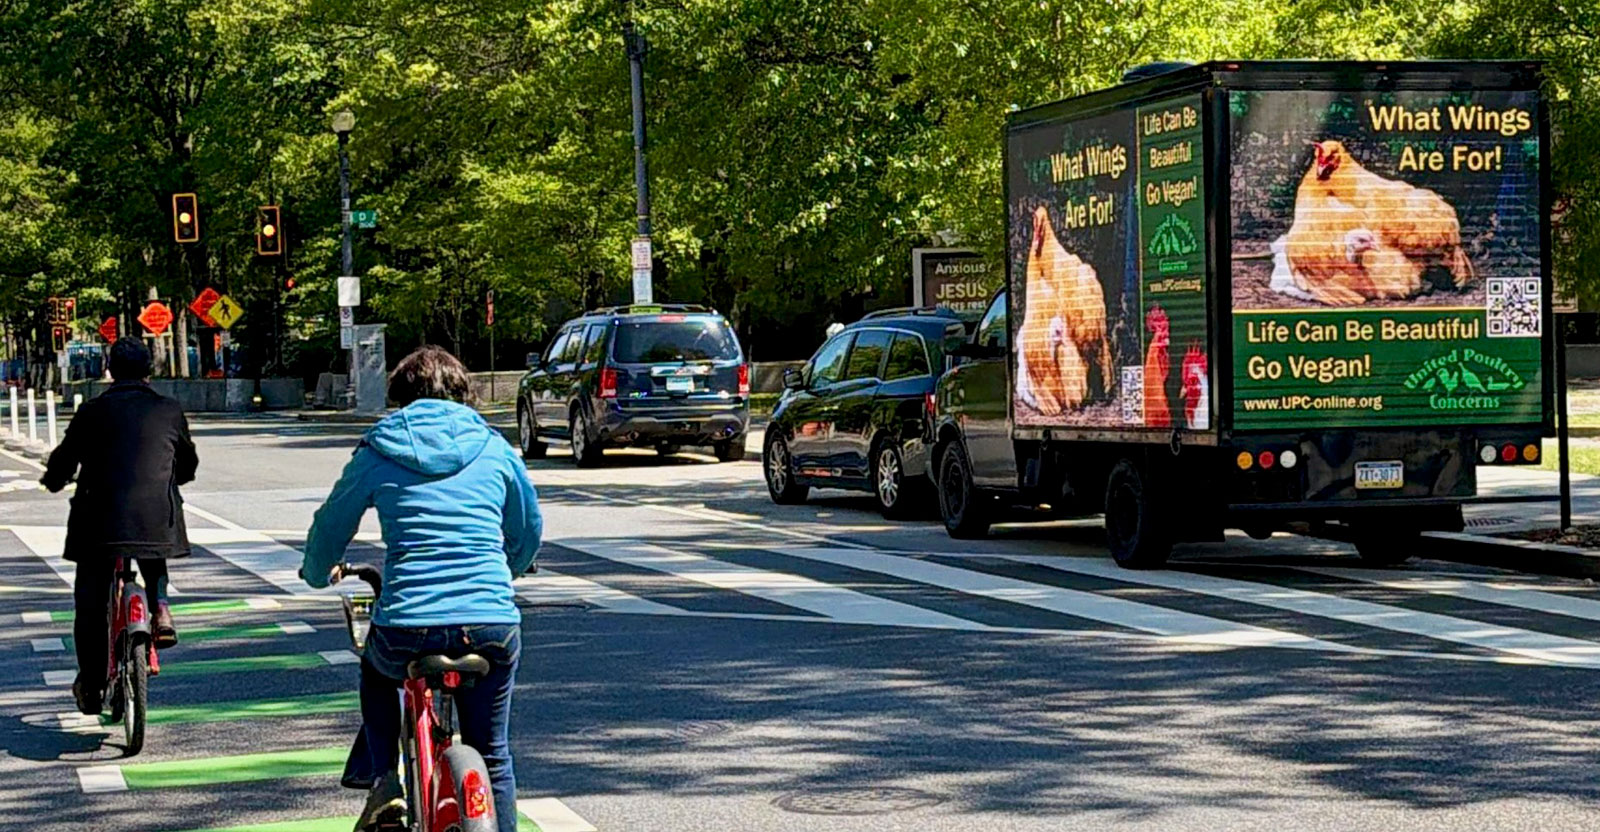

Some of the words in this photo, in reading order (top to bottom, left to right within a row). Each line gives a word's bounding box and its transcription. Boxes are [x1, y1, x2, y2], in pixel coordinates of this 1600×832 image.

[1144, 112, 1162, 135] Life
[1162, 110, 1182, 132] Can
[1183, 106, 1197, 127] Be
[1369, 105, 1441, 131] What
[1448, 105, 1531, 136] Wings
[1051, 152, 1084, 183] What
[1086, 143, 1127, 179] Wings
[1150, 141, 1192, 168] Beautiful
[1399, 145, 1444, 171] Are
[1453, 145, 1502, 171] For!
[1146, 183, 1161, 205] Go
[1162, 176, 1197, 206] Vegan!
[1065, 200, 1086, 229] Are
[1089, 193, 1114, 225] For!
[935, 282, 988, 299] JESUS
[1247, 320, 1289, 343] Life
[1295, 320, 1338, 342] Can
[1345, 319, 1374, 341] Be
[1381, 318, 1479, 341] Beautiful
[1247, 355, 1283, 380] Go
[1288, 354, 1371, 383] Vegan!
[1403, 349, 1458, 389] United
[1463, 348, 1524, 389] Poultry
[1244, 395, 1383, 411] www.UPC-online.org
[1429, 393, 1500, 410] Concerns
